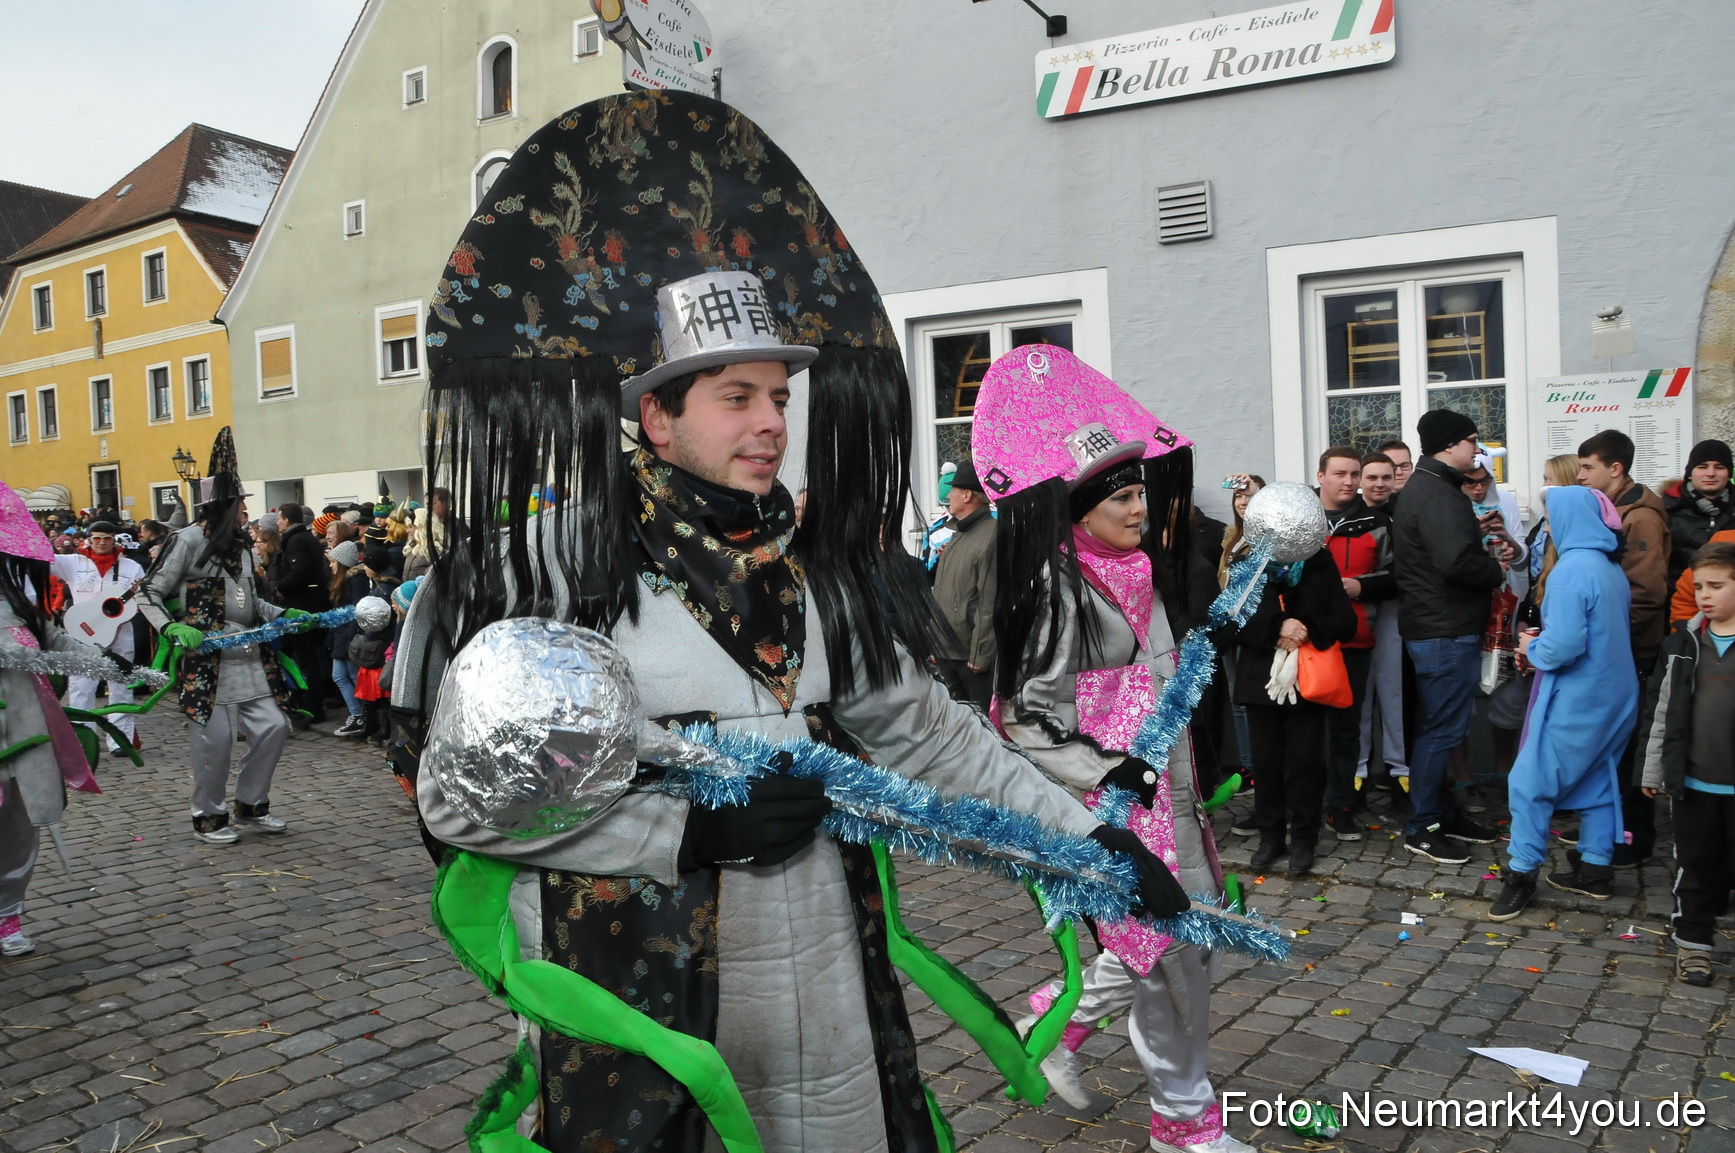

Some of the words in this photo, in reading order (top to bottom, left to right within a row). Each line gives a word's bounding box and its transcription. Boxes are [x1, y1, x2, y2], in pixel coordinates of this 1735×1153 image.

[658, 12, 682, 32] Café
[1102, 36, 1169, 58] Pizzeria
[1189, 24, 1229, 44] Café
[1247, 7, 1320, 31] Eisdiele
[645, 26, 693, 58] Eisdiele
[631, 68, 669, 90] Roma
[655, 68, 688, 89] Bella
[1091, 57, 1191, 100] Bella
[1203, 41, 1323, 82] Roma
[1546, 391, 1596, 403] Bella
[1565, 403, 1621, 414] Roma
